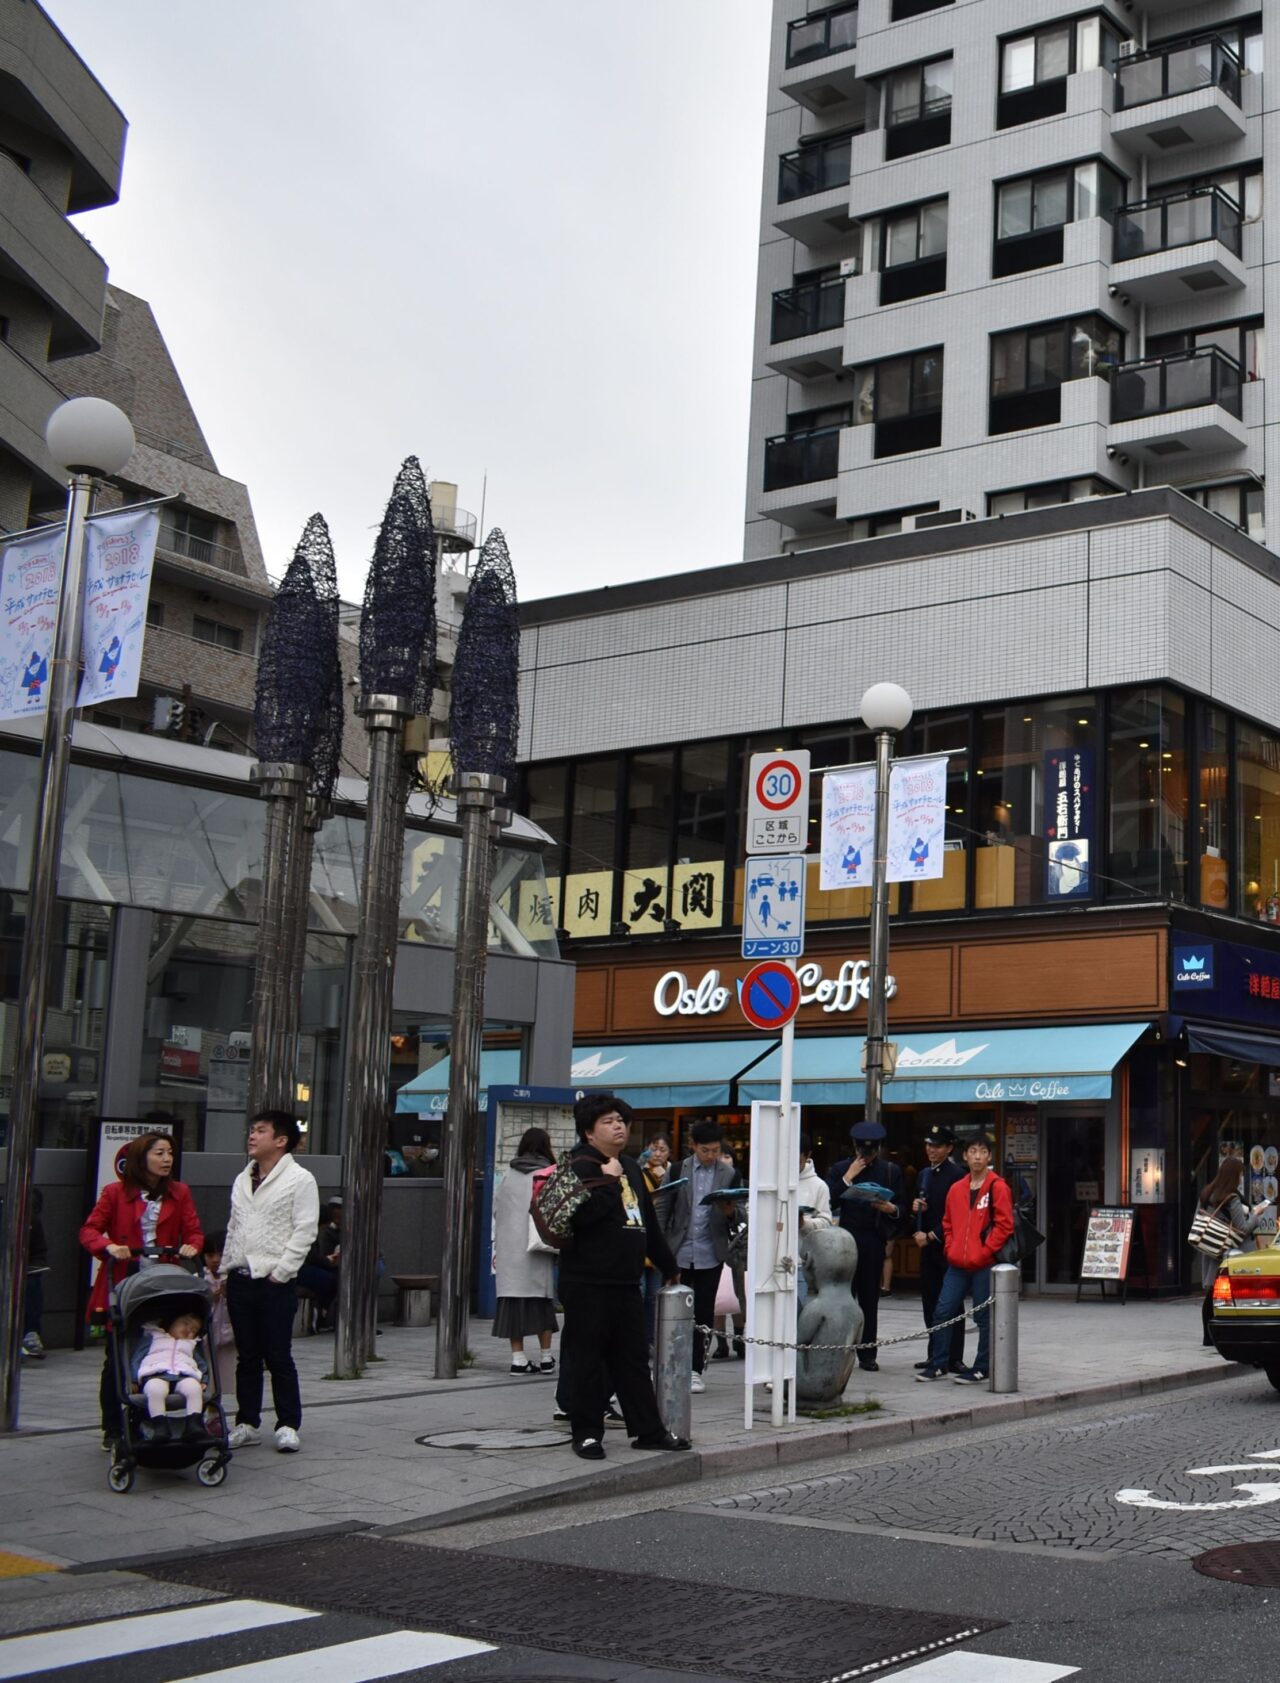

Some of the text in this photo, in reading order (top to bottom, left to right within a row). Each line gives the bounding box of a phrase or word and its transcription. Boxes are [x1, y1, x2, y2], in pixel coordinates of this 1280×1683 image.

[105, 543, 141, 571] 2018
[766, 774, 792, 797] 30
[765, 819, 789, 832] 区域
[755, 832, 798, 845] ここから
[745, 941, 799, 956] ゾーン30
[1176, 971, 1211, 982] Oslo Coffee
[653, 969, 732, 1016] Oslo
[898, 1057, 964, 1067] COFFEE
[512, 1089, 531, 1098] ご案内
[975, 1080, 1070, 1100] Oslo Coffee
